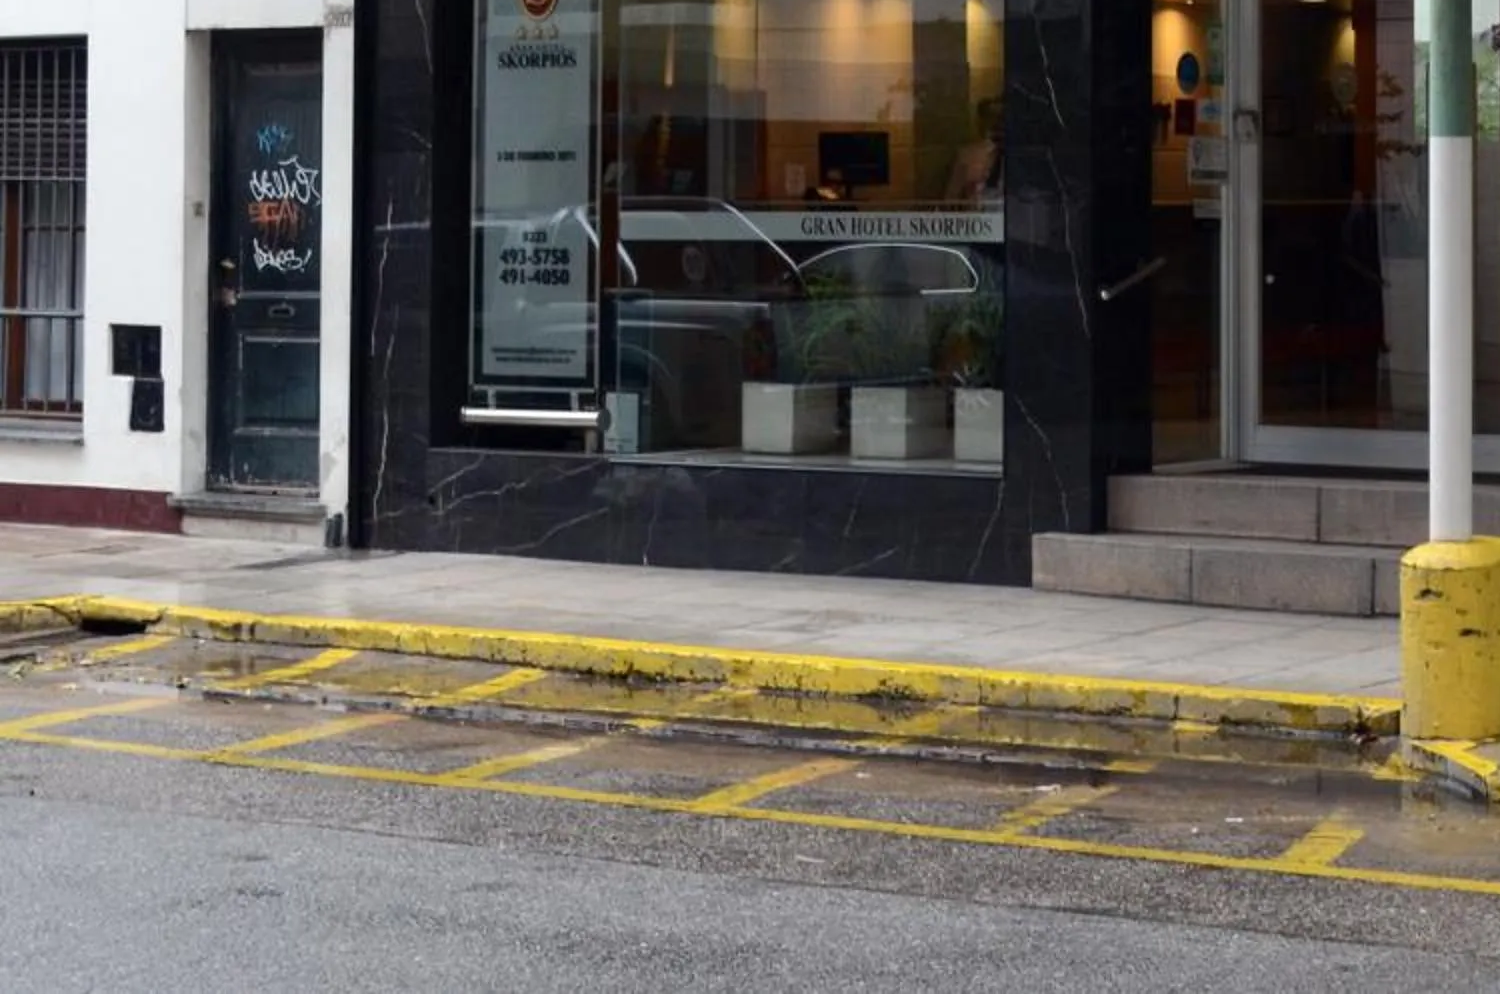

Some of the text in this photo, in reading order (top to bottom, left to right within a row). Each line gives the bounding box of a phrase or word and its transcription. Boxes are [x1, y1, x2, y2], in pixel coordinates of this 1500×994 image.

[497, 52, 578, 70] SKORPIOS
[801, 216, 993, 237] GRAN HOTEL SKORPIOS
